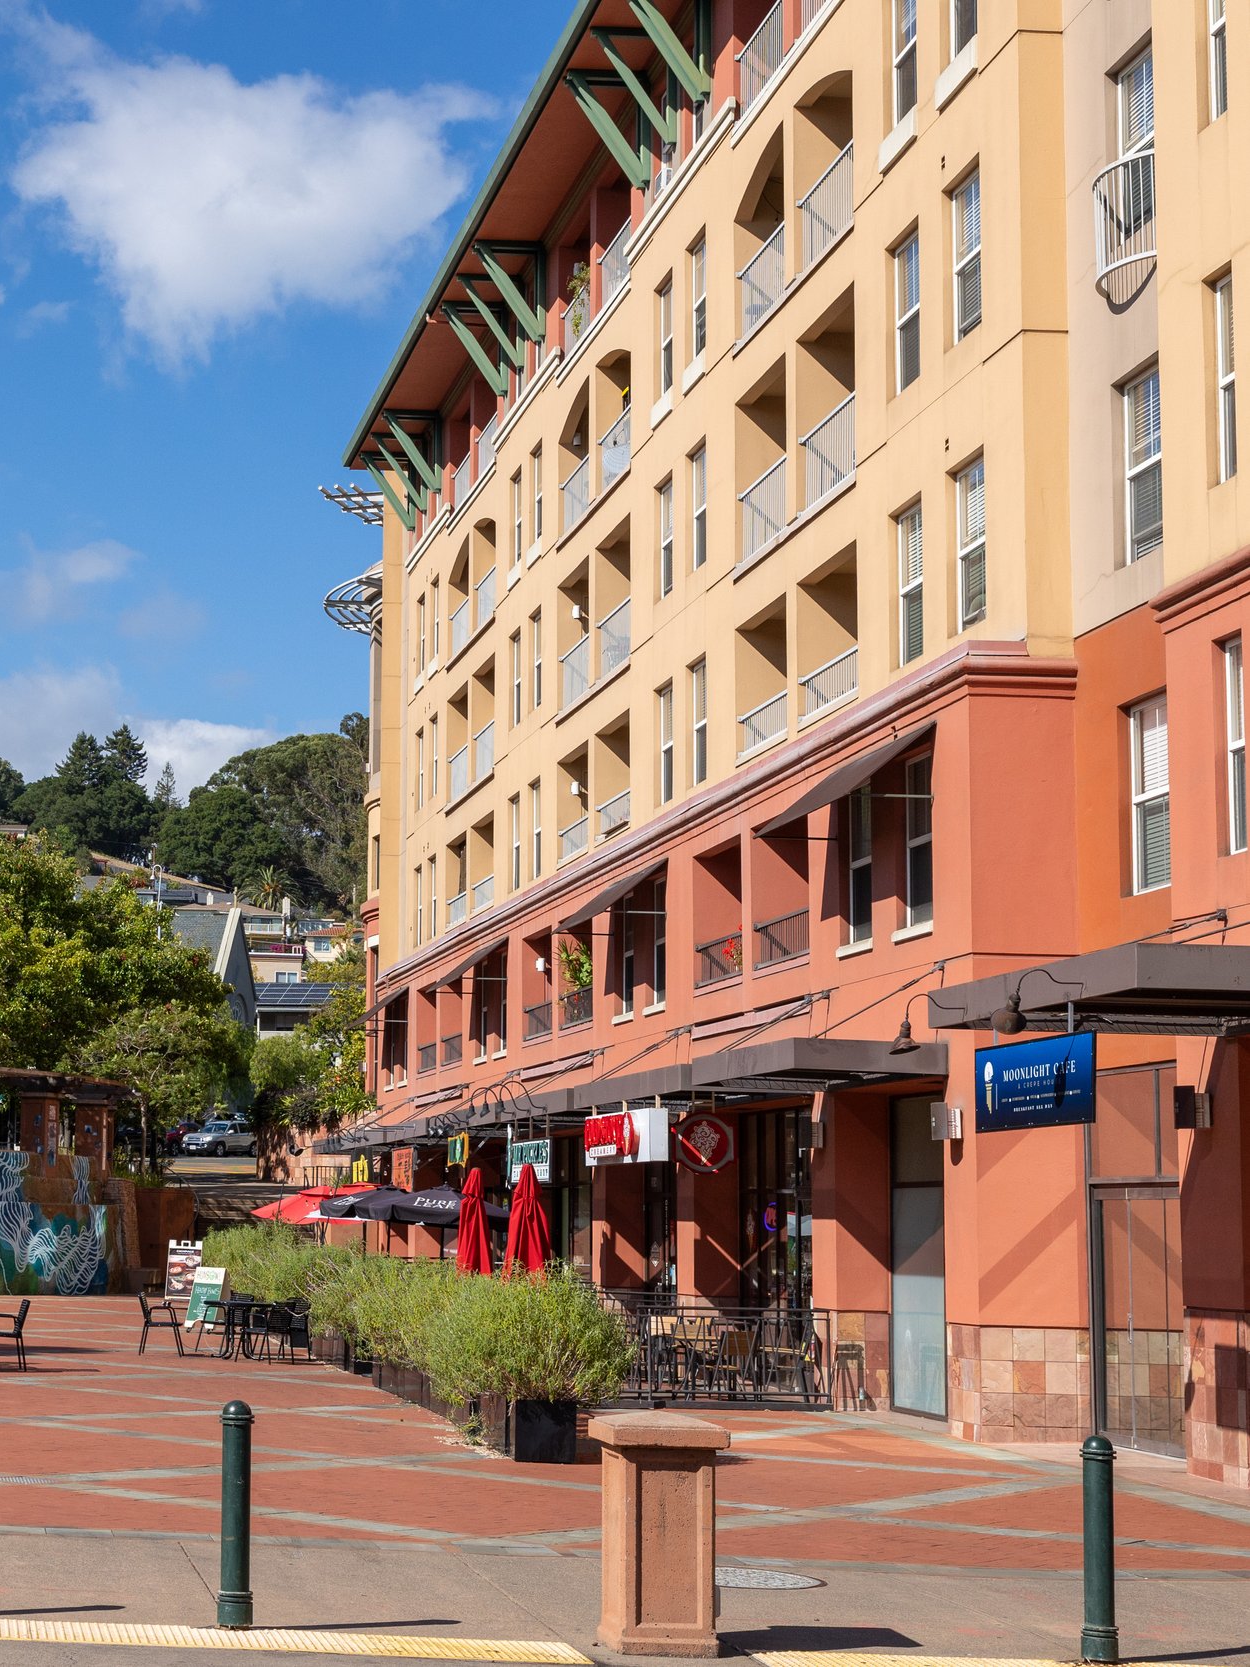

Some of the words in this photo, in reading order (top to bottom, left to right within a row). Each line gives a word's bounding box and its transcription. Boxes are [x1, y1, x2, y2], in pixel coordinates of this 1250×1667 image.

[1003, 1063, 1051, 1082] MOONLIGHT
[1053, 1060, 1076, 1075] CAFE
[1023, 1080, 1040, 1088] CREPE
[415, 1196, 457, 1205] PURE
